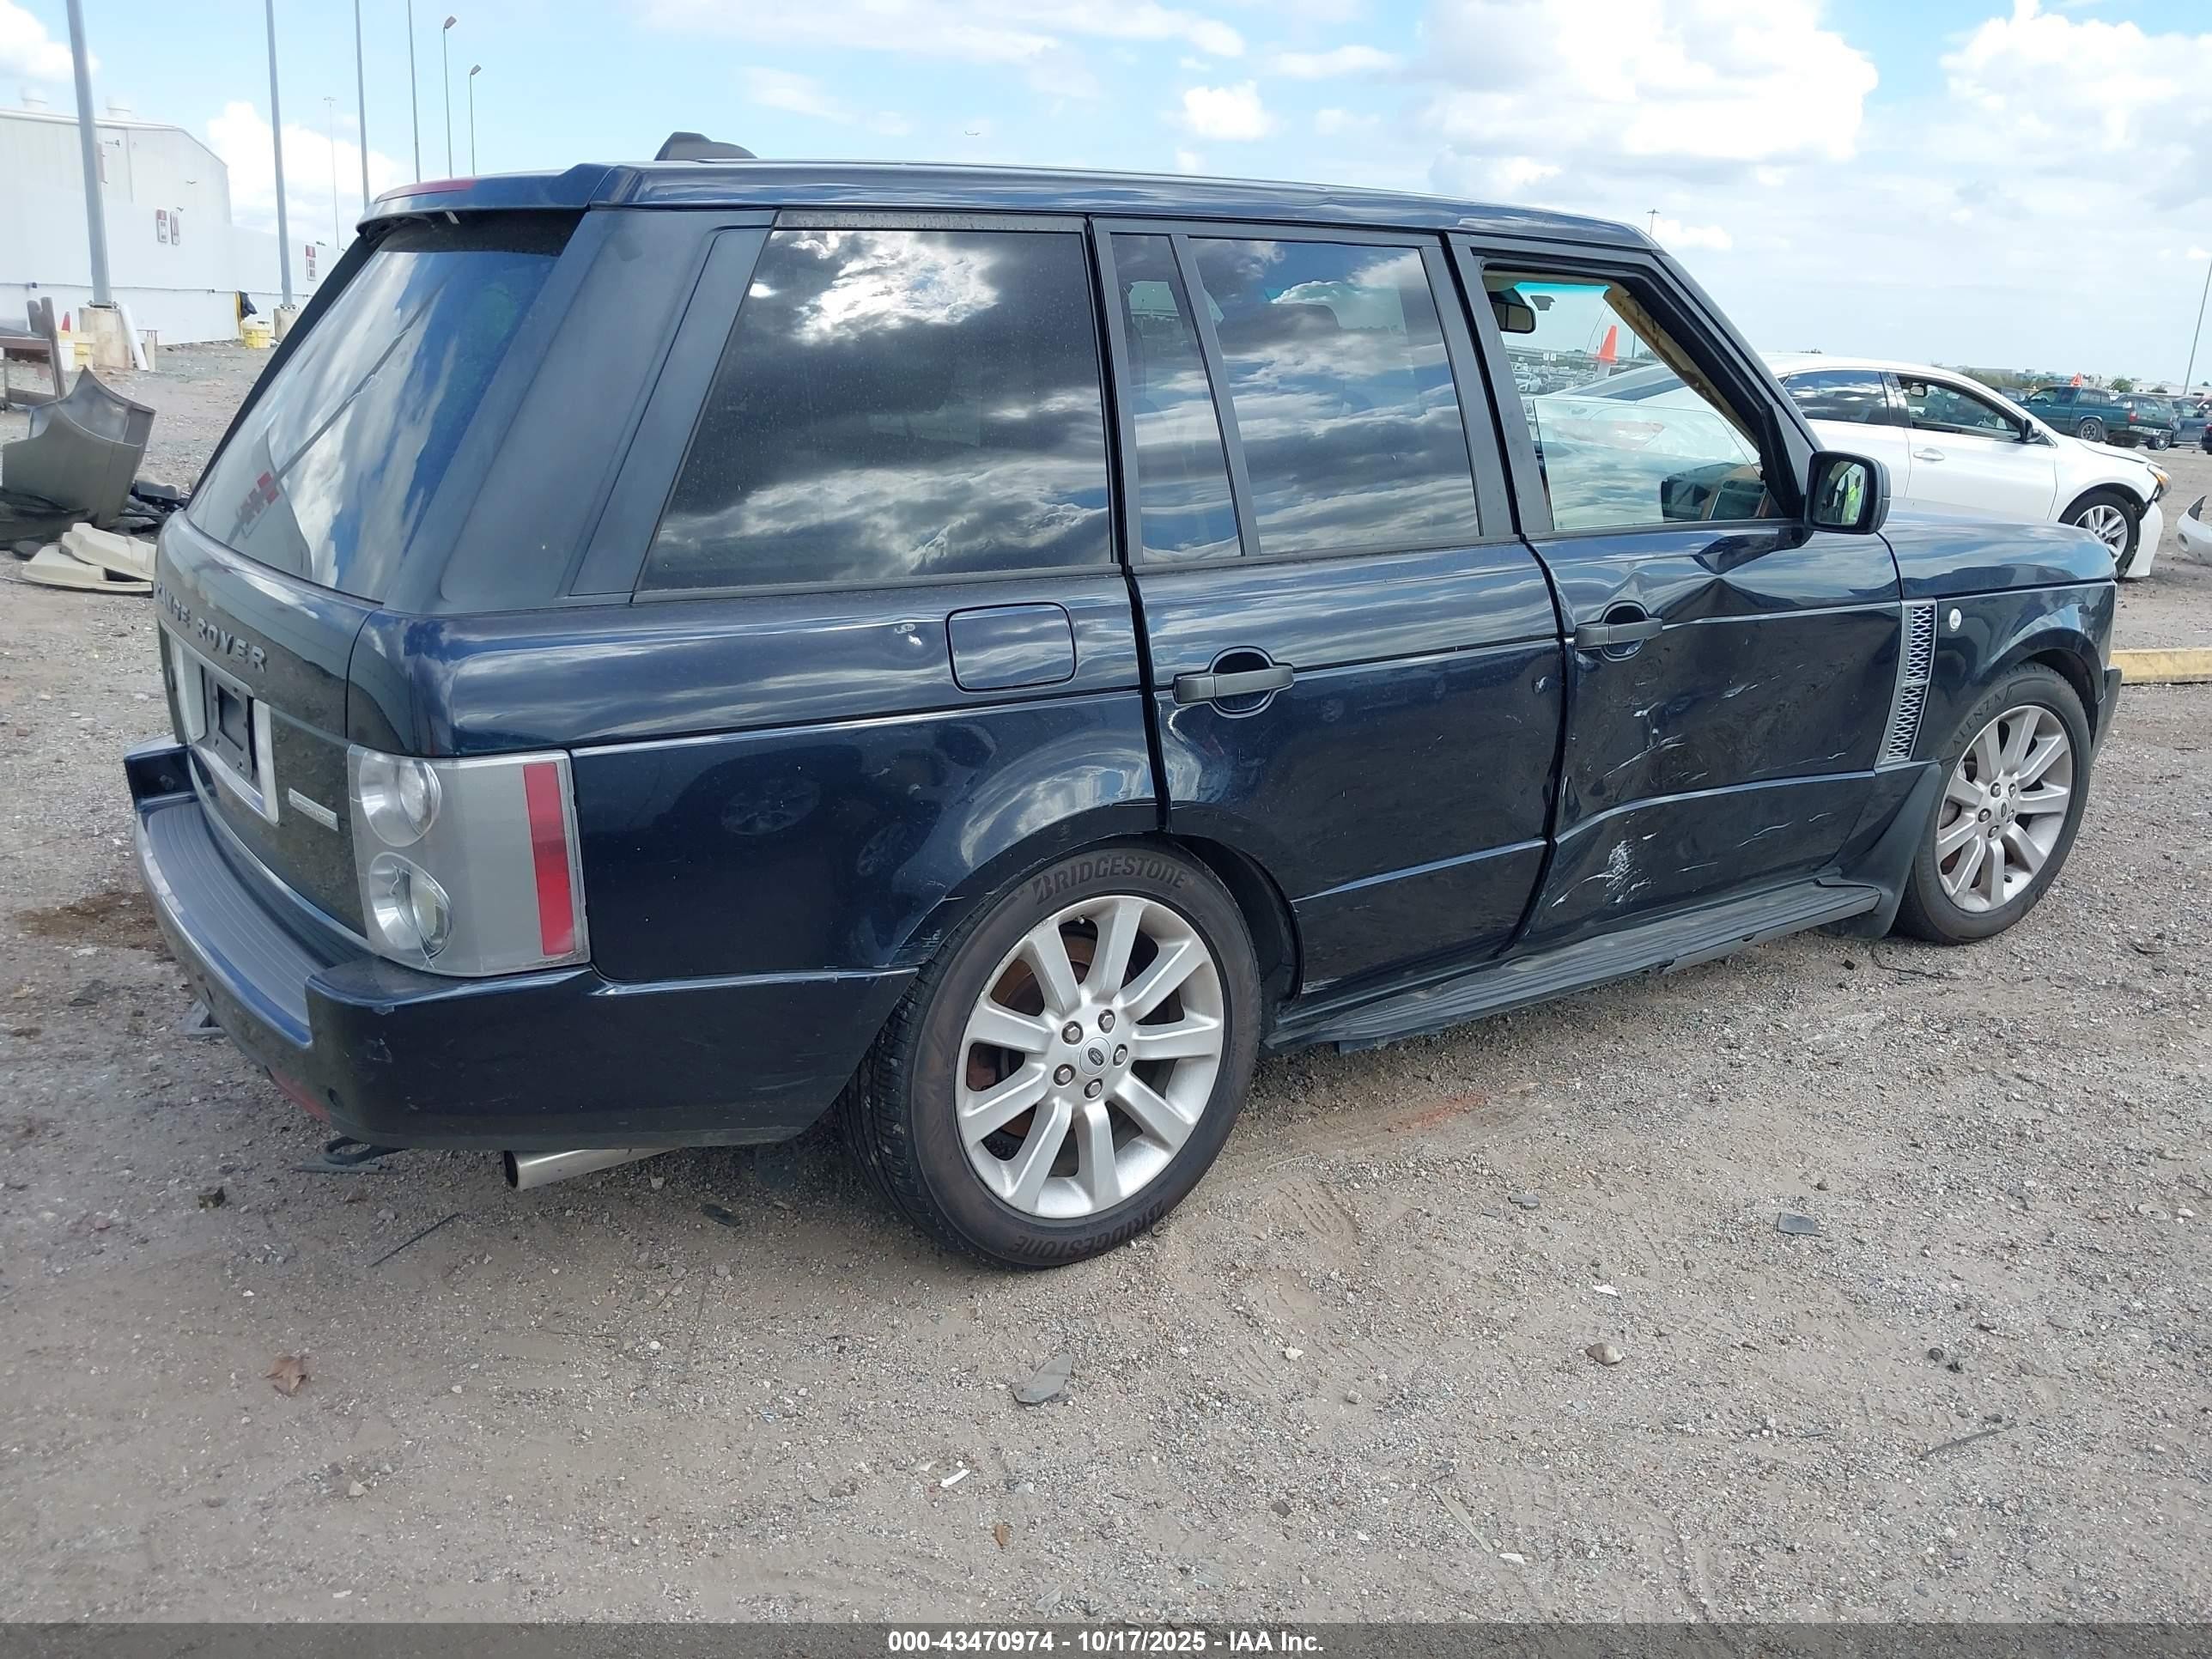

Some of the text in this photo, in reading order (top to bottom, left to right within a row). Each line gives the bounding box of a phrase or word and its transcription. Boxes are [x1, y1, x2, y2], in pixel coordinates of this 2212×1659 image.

[197, 617, 267, 673] ROVER
[1032, 856, 1187, 905] BRIDGESTONE
[1010, 1200, 1165, 1260] BRIDGESTONE
